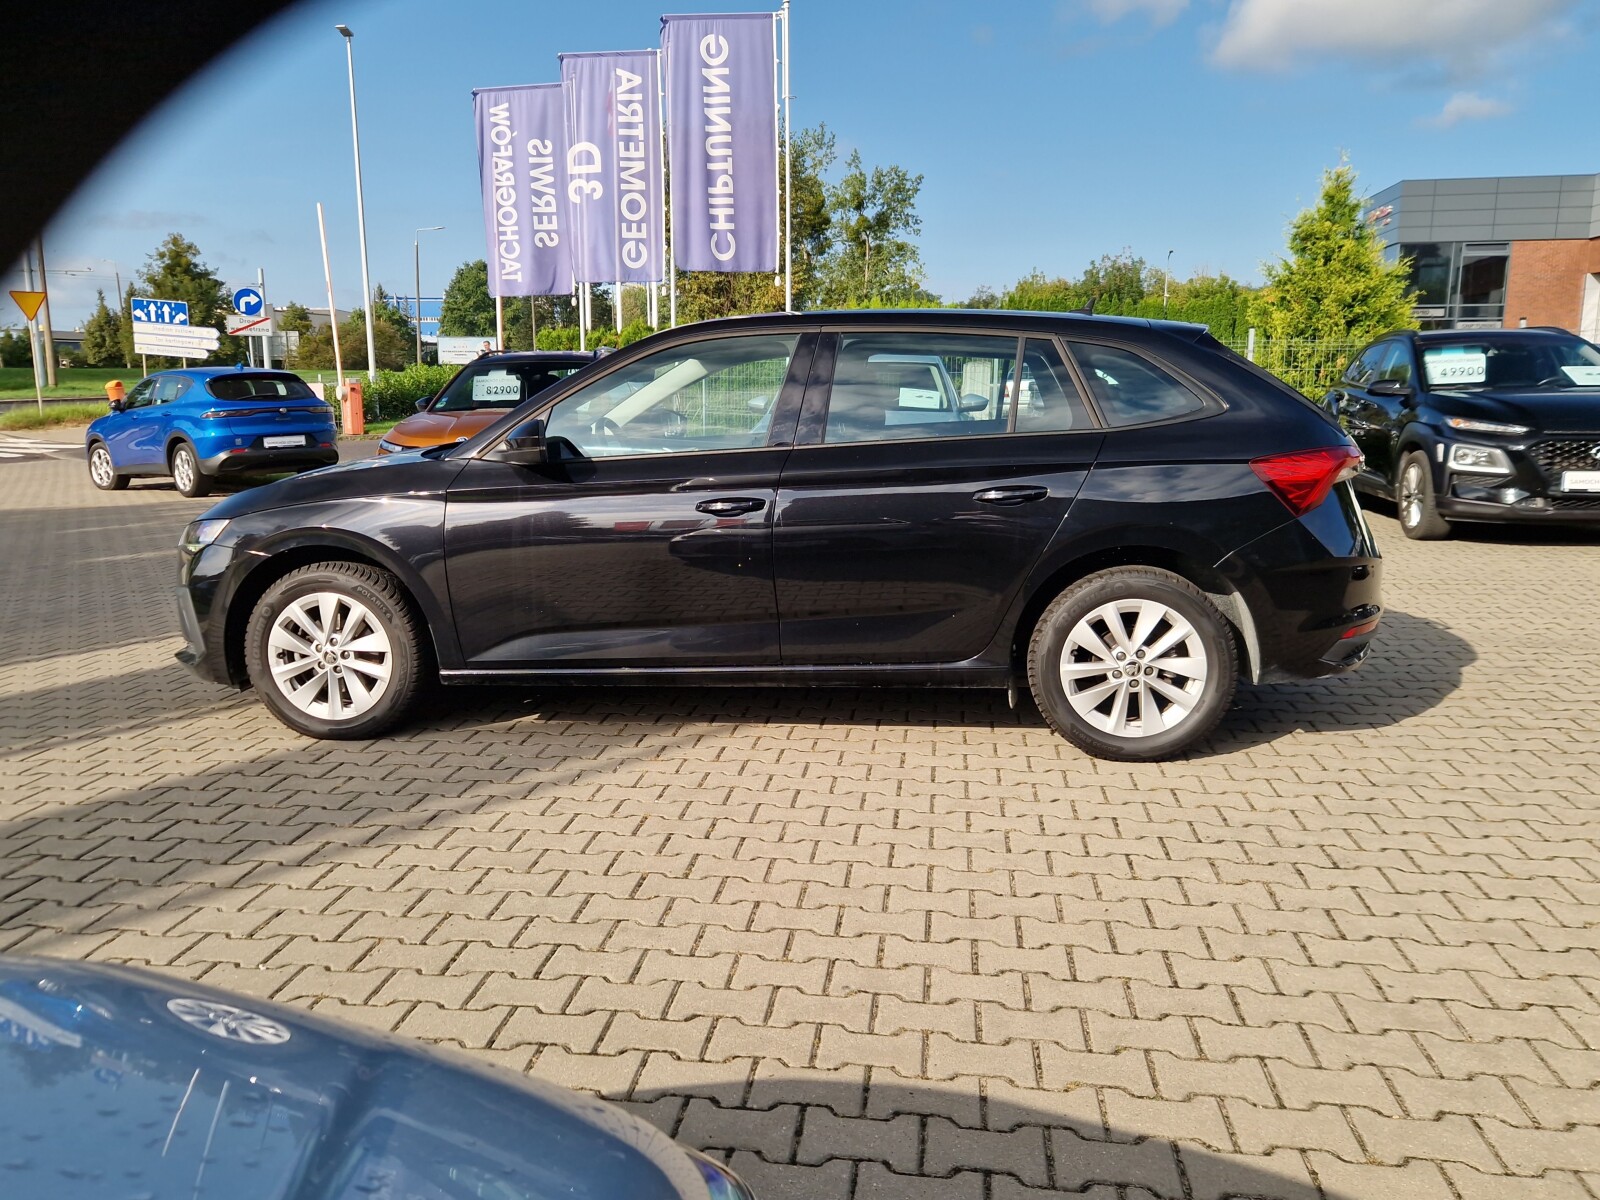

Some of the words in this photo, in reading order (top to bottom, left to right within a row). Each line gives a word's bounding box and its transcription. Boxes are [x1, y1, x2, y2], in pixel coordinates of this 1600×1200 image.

[1440, 366, 1485, 377] 49900
[486, 385, 519, 395] 82900
[356, 586, 386, 613] POLARIS
